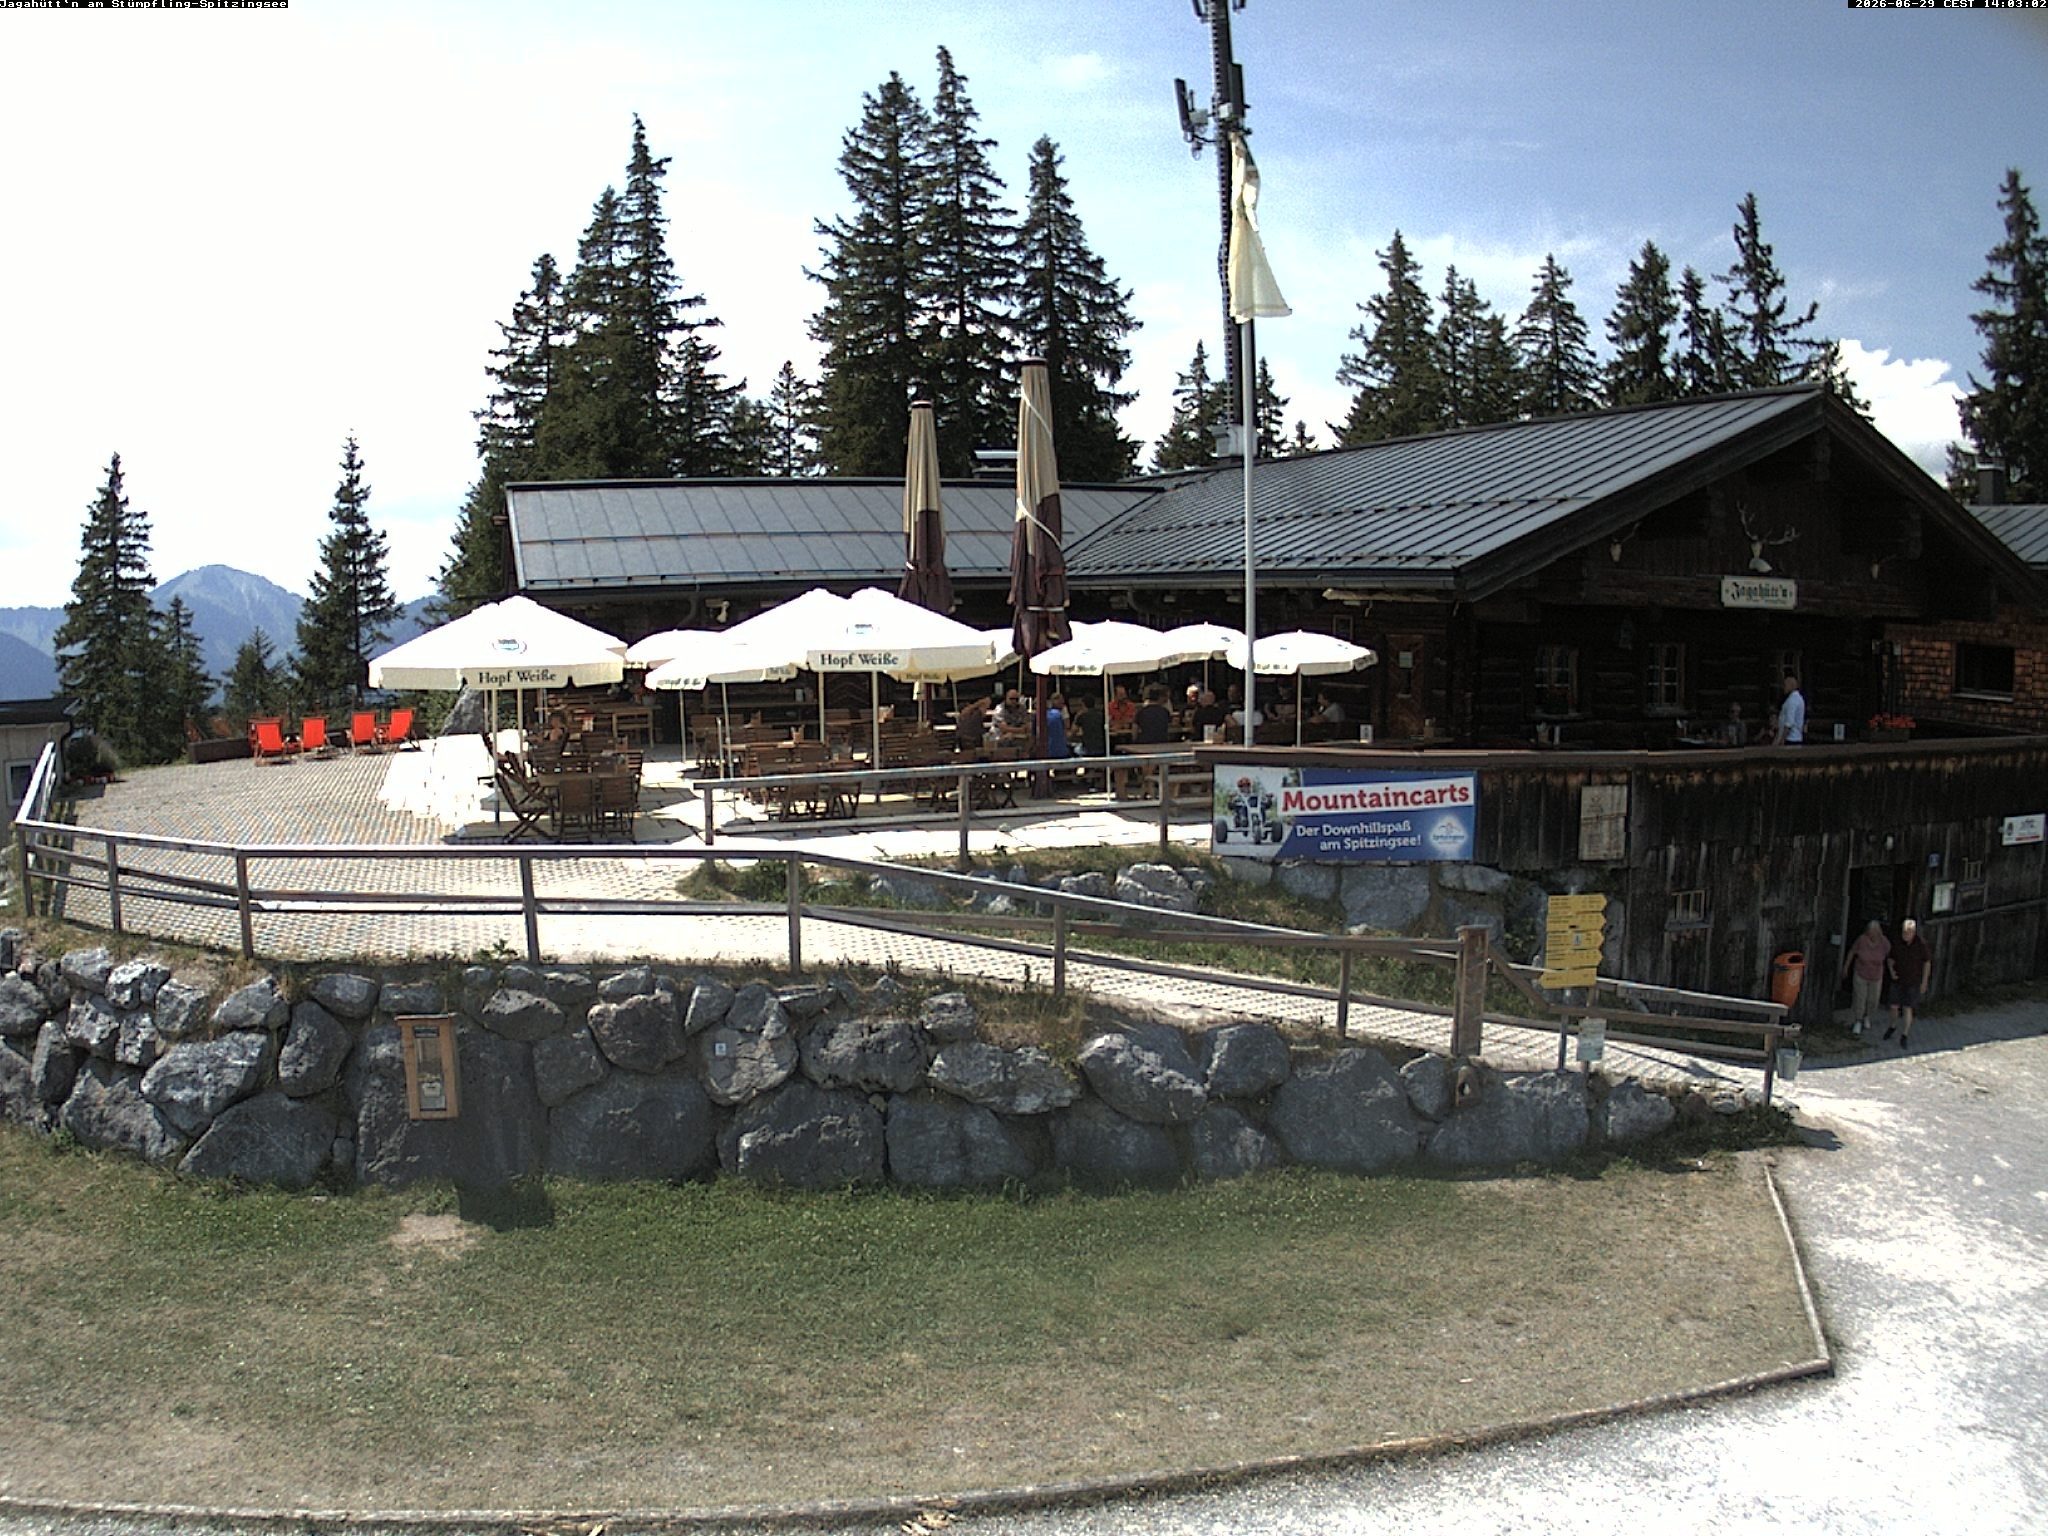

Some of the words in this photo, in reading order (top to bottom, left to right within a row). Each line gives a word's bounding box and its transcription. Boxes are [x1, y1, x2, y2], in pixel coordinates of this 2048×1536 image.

[819, 653, 854, 668] Hopf
[858, 653, 898, 665] Weiße
[479, 670, 512, 686] Hopf
[517, 669, 557, 683] Weiße
[1282, 783, 1470, 812] Mountaincarts
[1296, 824, 1319, 837] Der
[1322, 820, 1412, 836] Downhillspaß
[1320, 839, 1341, 850] am
[1344, 834, 1422, 851] Spitzingsee!
